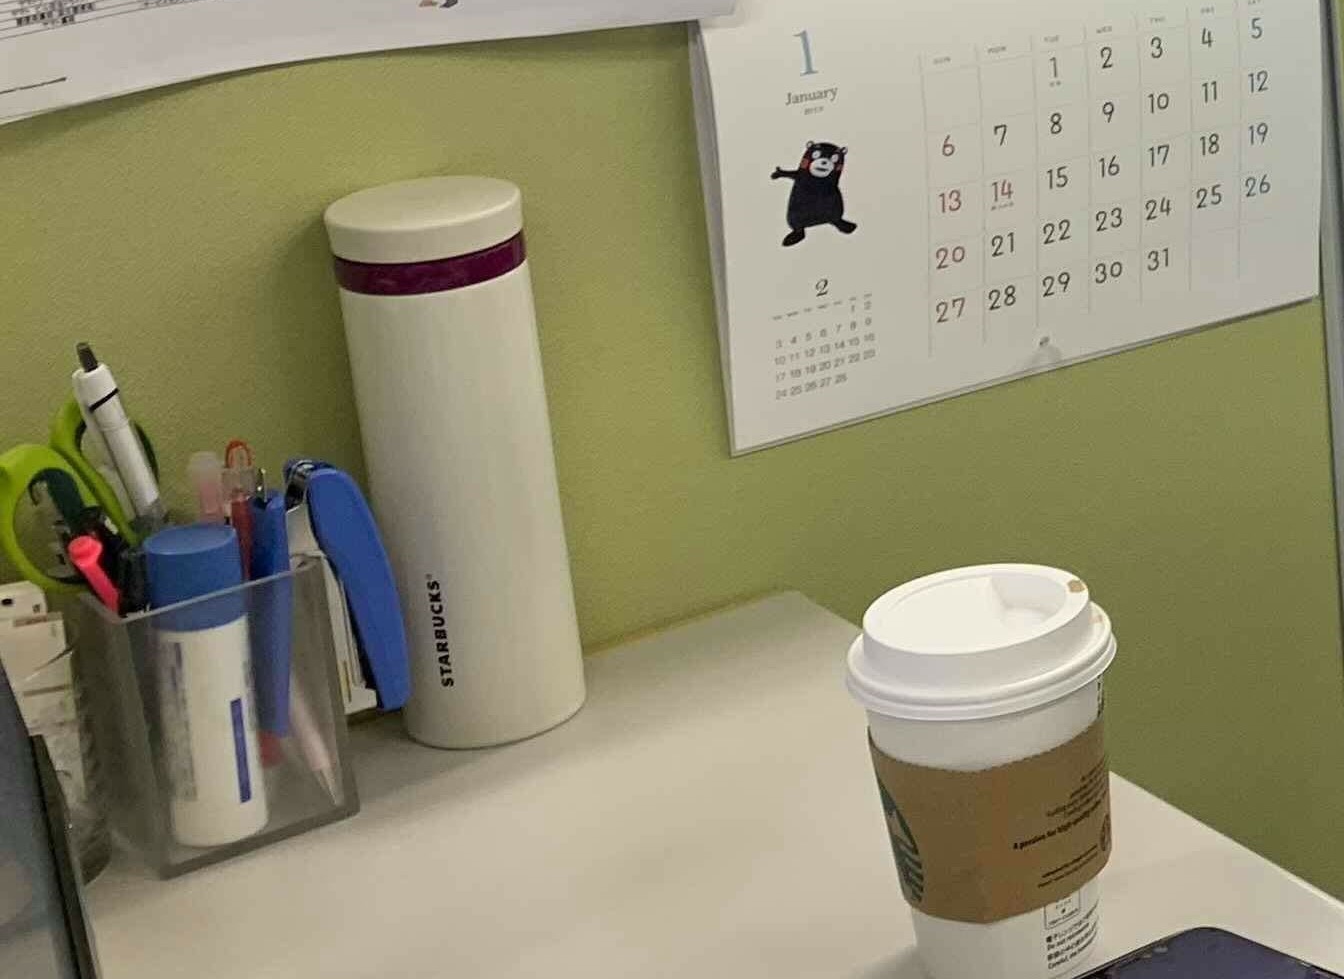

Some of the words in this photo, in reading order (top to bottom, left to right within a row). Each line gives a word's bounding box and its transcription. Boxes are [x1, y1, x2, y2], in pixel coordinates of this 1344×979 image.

[791, 29, 819, 77] 1
[1050, 56, 1058, 78] 1
[1100, 46, 1113, 69] 2
[1151, 36, 1163, 59] 3
[1201, 27, 1214, 48] 4
[1251, 17, 1263, 39] 5
[785, 87, 838, 106] January
[941, 134, 956, 157] 6
[993, 124, 1008, 146] 7
[1050, 112, 1062, 135] 8
[1102, 101, 1115, 123] 9
[1147, 93, 1169, 114] 10
[1201, 80, 1218, 103] 11
[1248, 70, 1269, 93] 12
[938, 189, 962, 214] 13
[991, 179, 1014, 202] 14
[1046, 165, 1069, 190] 15
[1098, 155, 1120, 178] 16
[1149, 144, 1170, 167] 17
[1199, 133, 1220, 156] 18
[1248, 122, 1269, 145] 19
[935, 246, 966, 269] 20
[991, 231, 1015, 257] 21
[1042, 218, 1071, 245] 22
[1095, 207, 1123, 232] 23
[1145, 197, 1172, 221] 24
[1196, 184, 1222, 209] 25
[1244, 174, 1271, 198] 26
[815, 278, 829, 297] 2
[935, 297, 966, 323] 27
[988, 284, 1017, 311] 28
[1042, 271, 1071, 298] 29
[1094, 260, 1123, 284] 30
[1146, 247, 1170, 271] 31
[426, 579, 455, 688] STARBUCKS
